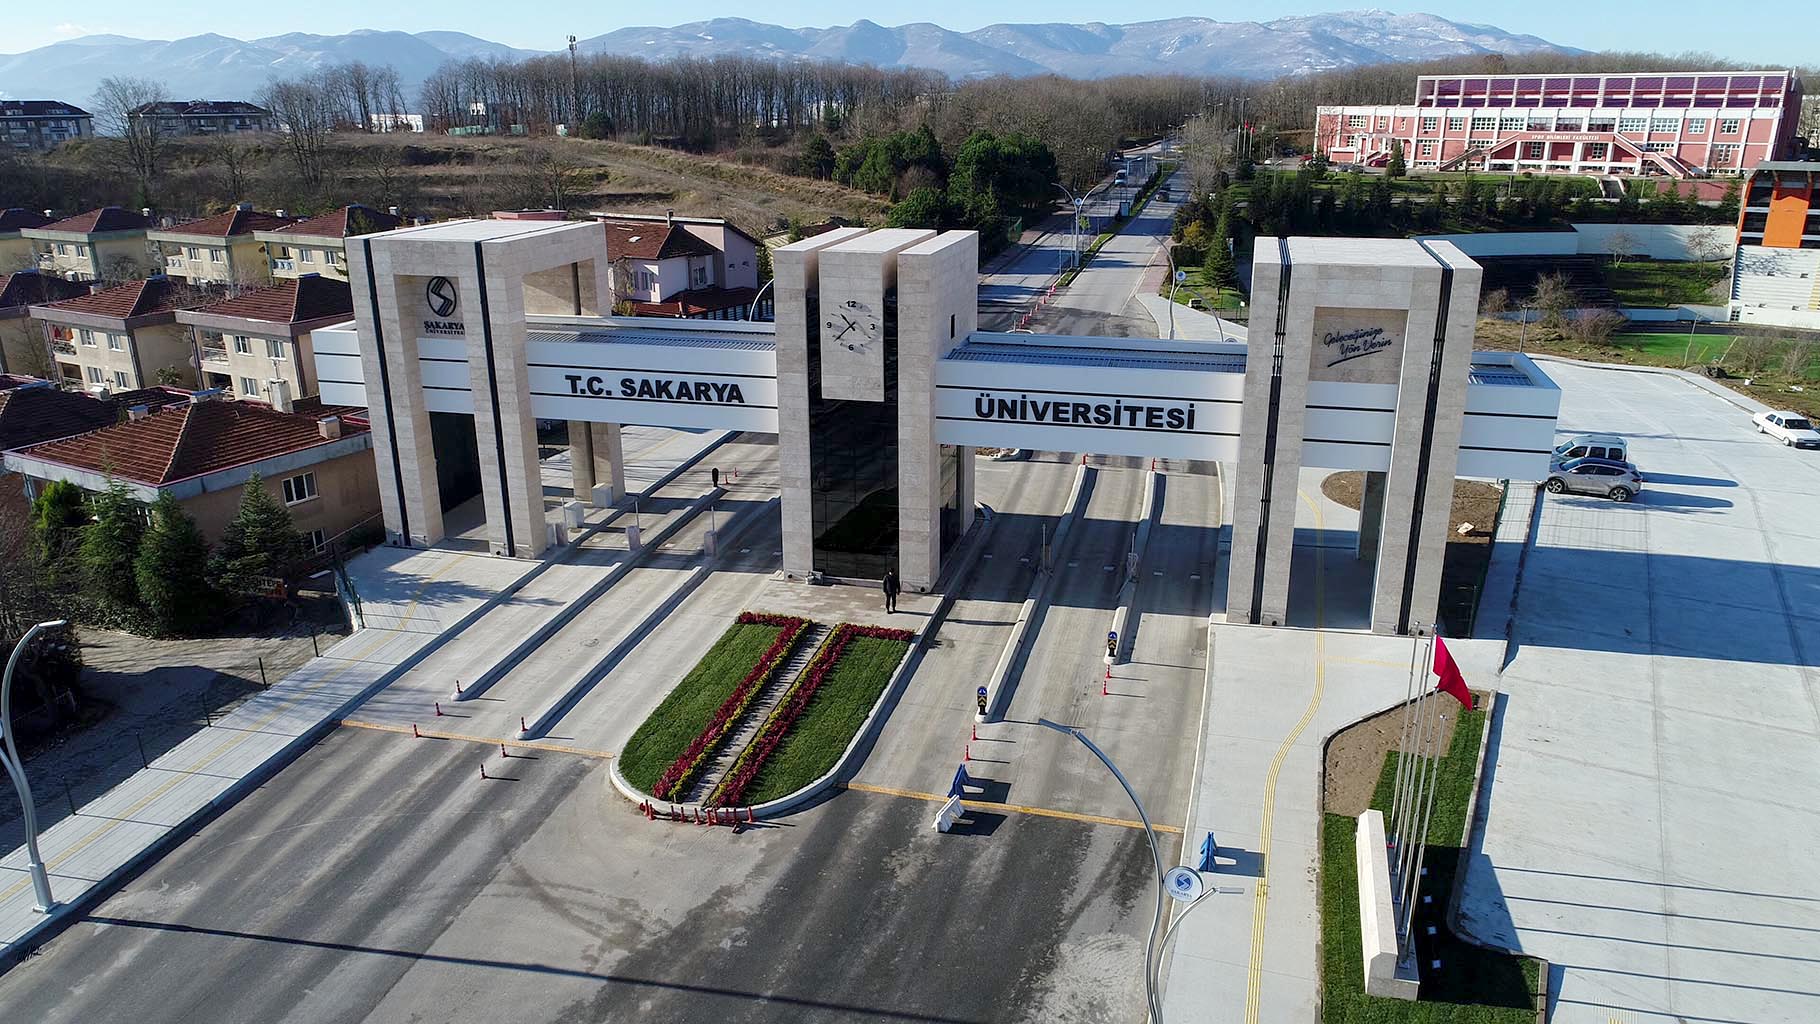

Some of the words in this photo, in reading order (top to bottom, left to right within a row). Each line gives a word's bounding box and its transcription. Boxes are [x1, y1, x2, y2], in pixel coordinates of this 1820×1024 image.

[424, 321, 465, 330] SAKARYA
[826, 321, 832, 329] 9
[1340, 344, 1361, 357] Yön
[1362, 338, 1393, 351] Verin
[564, 375, 612, 396] T.C.
[620, 378, 745, 403] SAKARYA
[975, 393, 1195, 429] ÜNİVERSİTESİ
